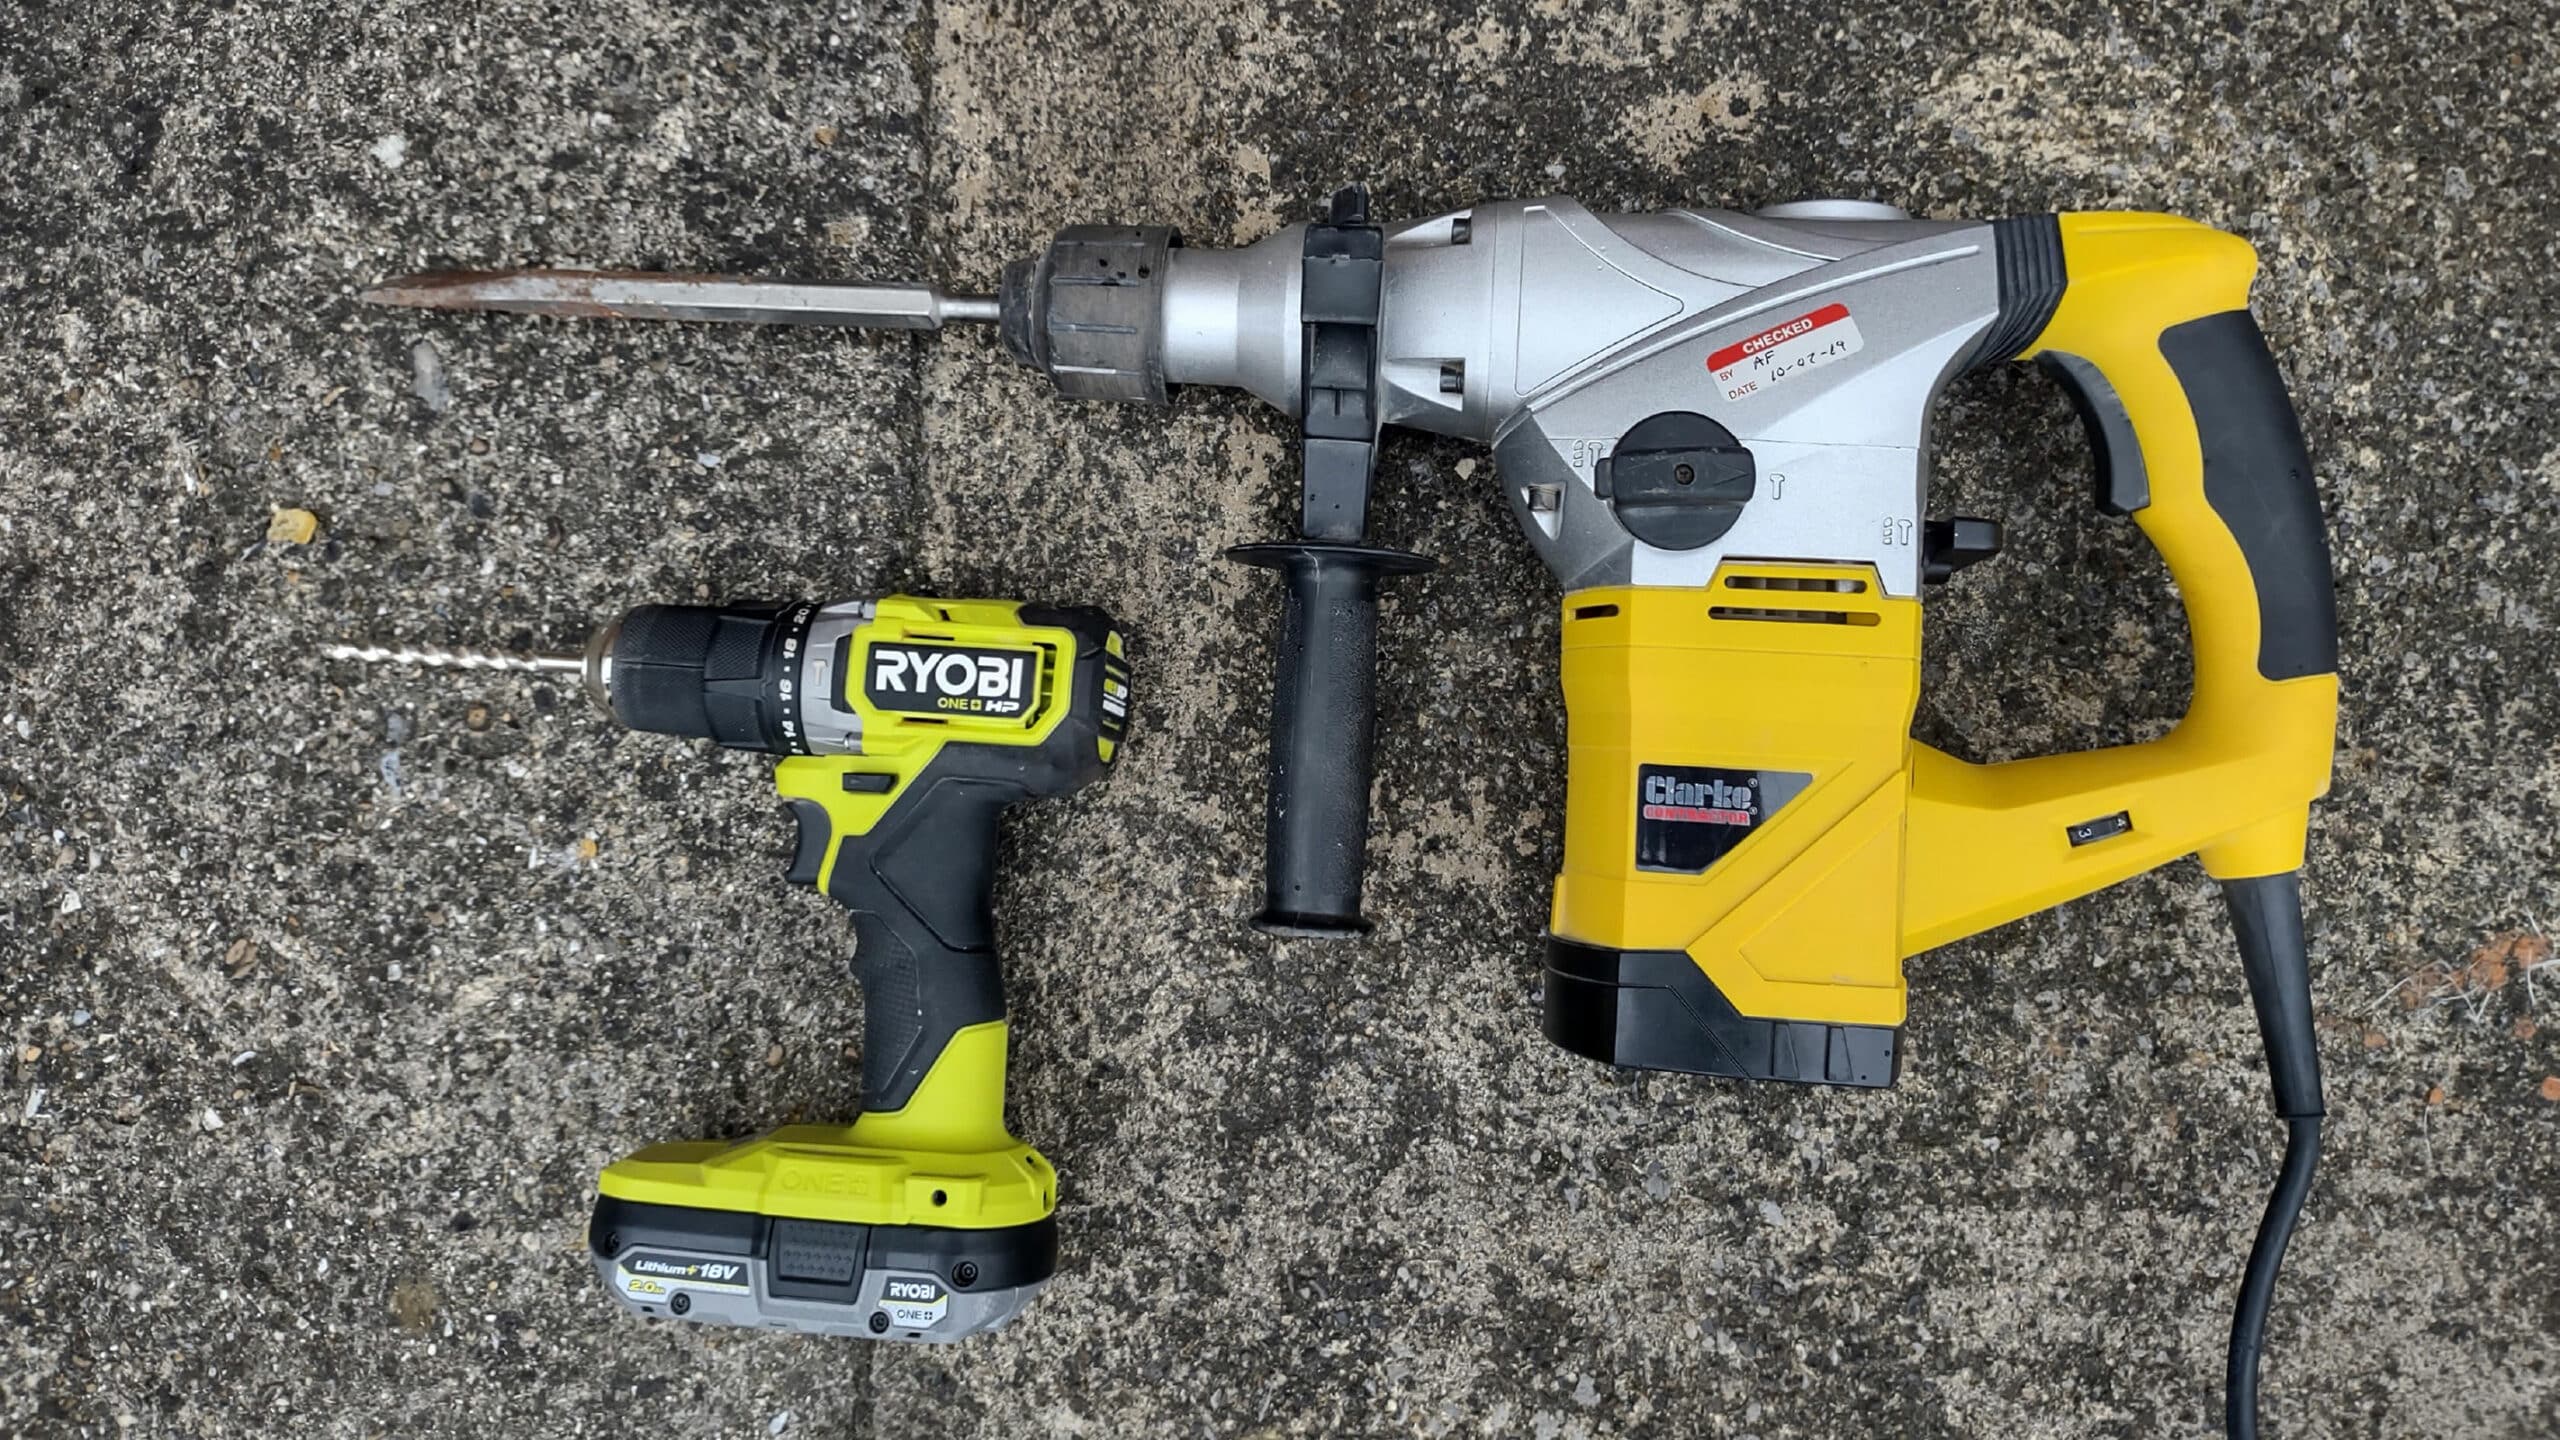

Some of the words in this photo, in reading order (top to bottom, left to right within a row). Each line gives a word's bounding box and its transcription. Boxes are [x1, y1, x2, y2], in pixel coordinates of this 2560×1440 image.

[1742, 318, 1813, 354] CHECKED
[1753, 350, 1775, 370] AF
[1719, 369, 1735, 382] BY
[1728, 381, 1758, 400] DATE
[793, 608, 810, 625] 20
[783, 638, 798, 659] 18
[874, 649, 1024, 699] RYOBI
[779, 678, 793, 701] 16
[985, 700, 1020, 713] HP
[781, 720, 797, 738] 14
[1645, 775, 1752, 810] Clarke
[2078, 828, 2092, 838] 3
[889, 1282, 935, 1299] RYOBI
